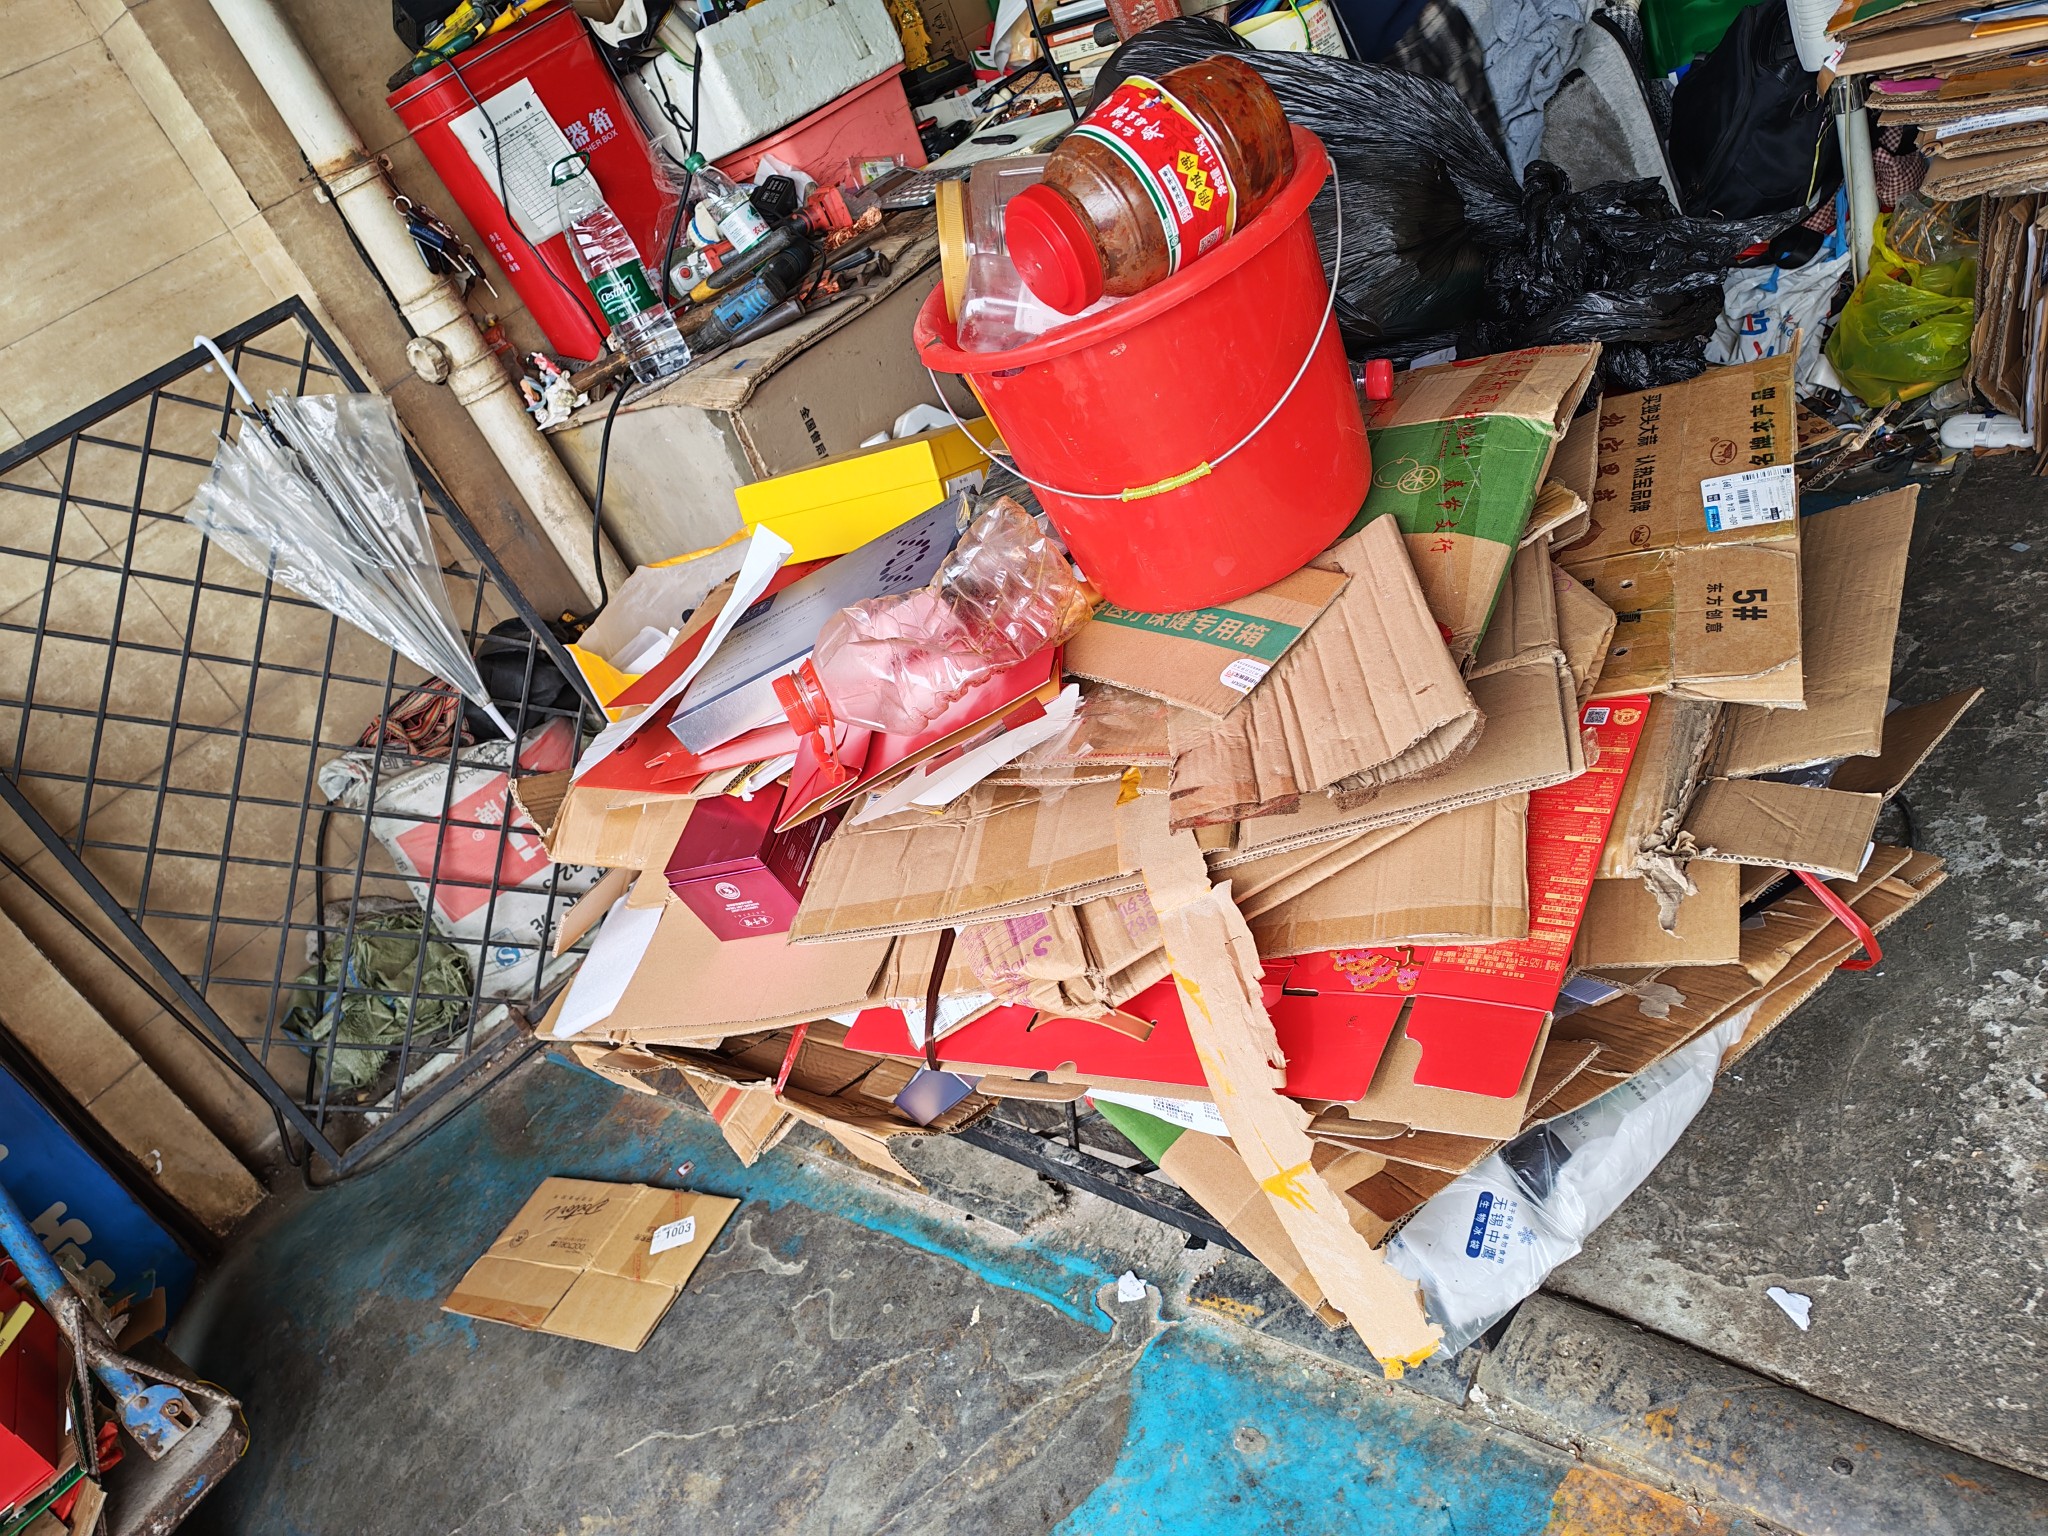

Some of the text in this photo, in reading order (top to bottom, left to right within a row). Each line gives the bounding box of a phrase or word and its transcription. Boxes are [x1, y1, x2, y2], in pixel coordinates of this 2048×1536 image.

[601, 129, 618, 144] BOX
[800, 406, 829, 459] 全国售后
[1749, 386, 1776, 466] 名牌农产品
[1628, 393, 1662, 514] 买独头大蒜 认热宝品牌
[1705, 583, 1725, 634] 东方创意
[1732, 588, 1768, 621] 5#
[665, 1222, 693, 1240] 1003
[1470, 1199, 1491, 1250] 生物冰袋
[1480, 1196, 1508, 1265] 无锡中鹰
[1505, 1200, 1518, 1230] 用于保冷
